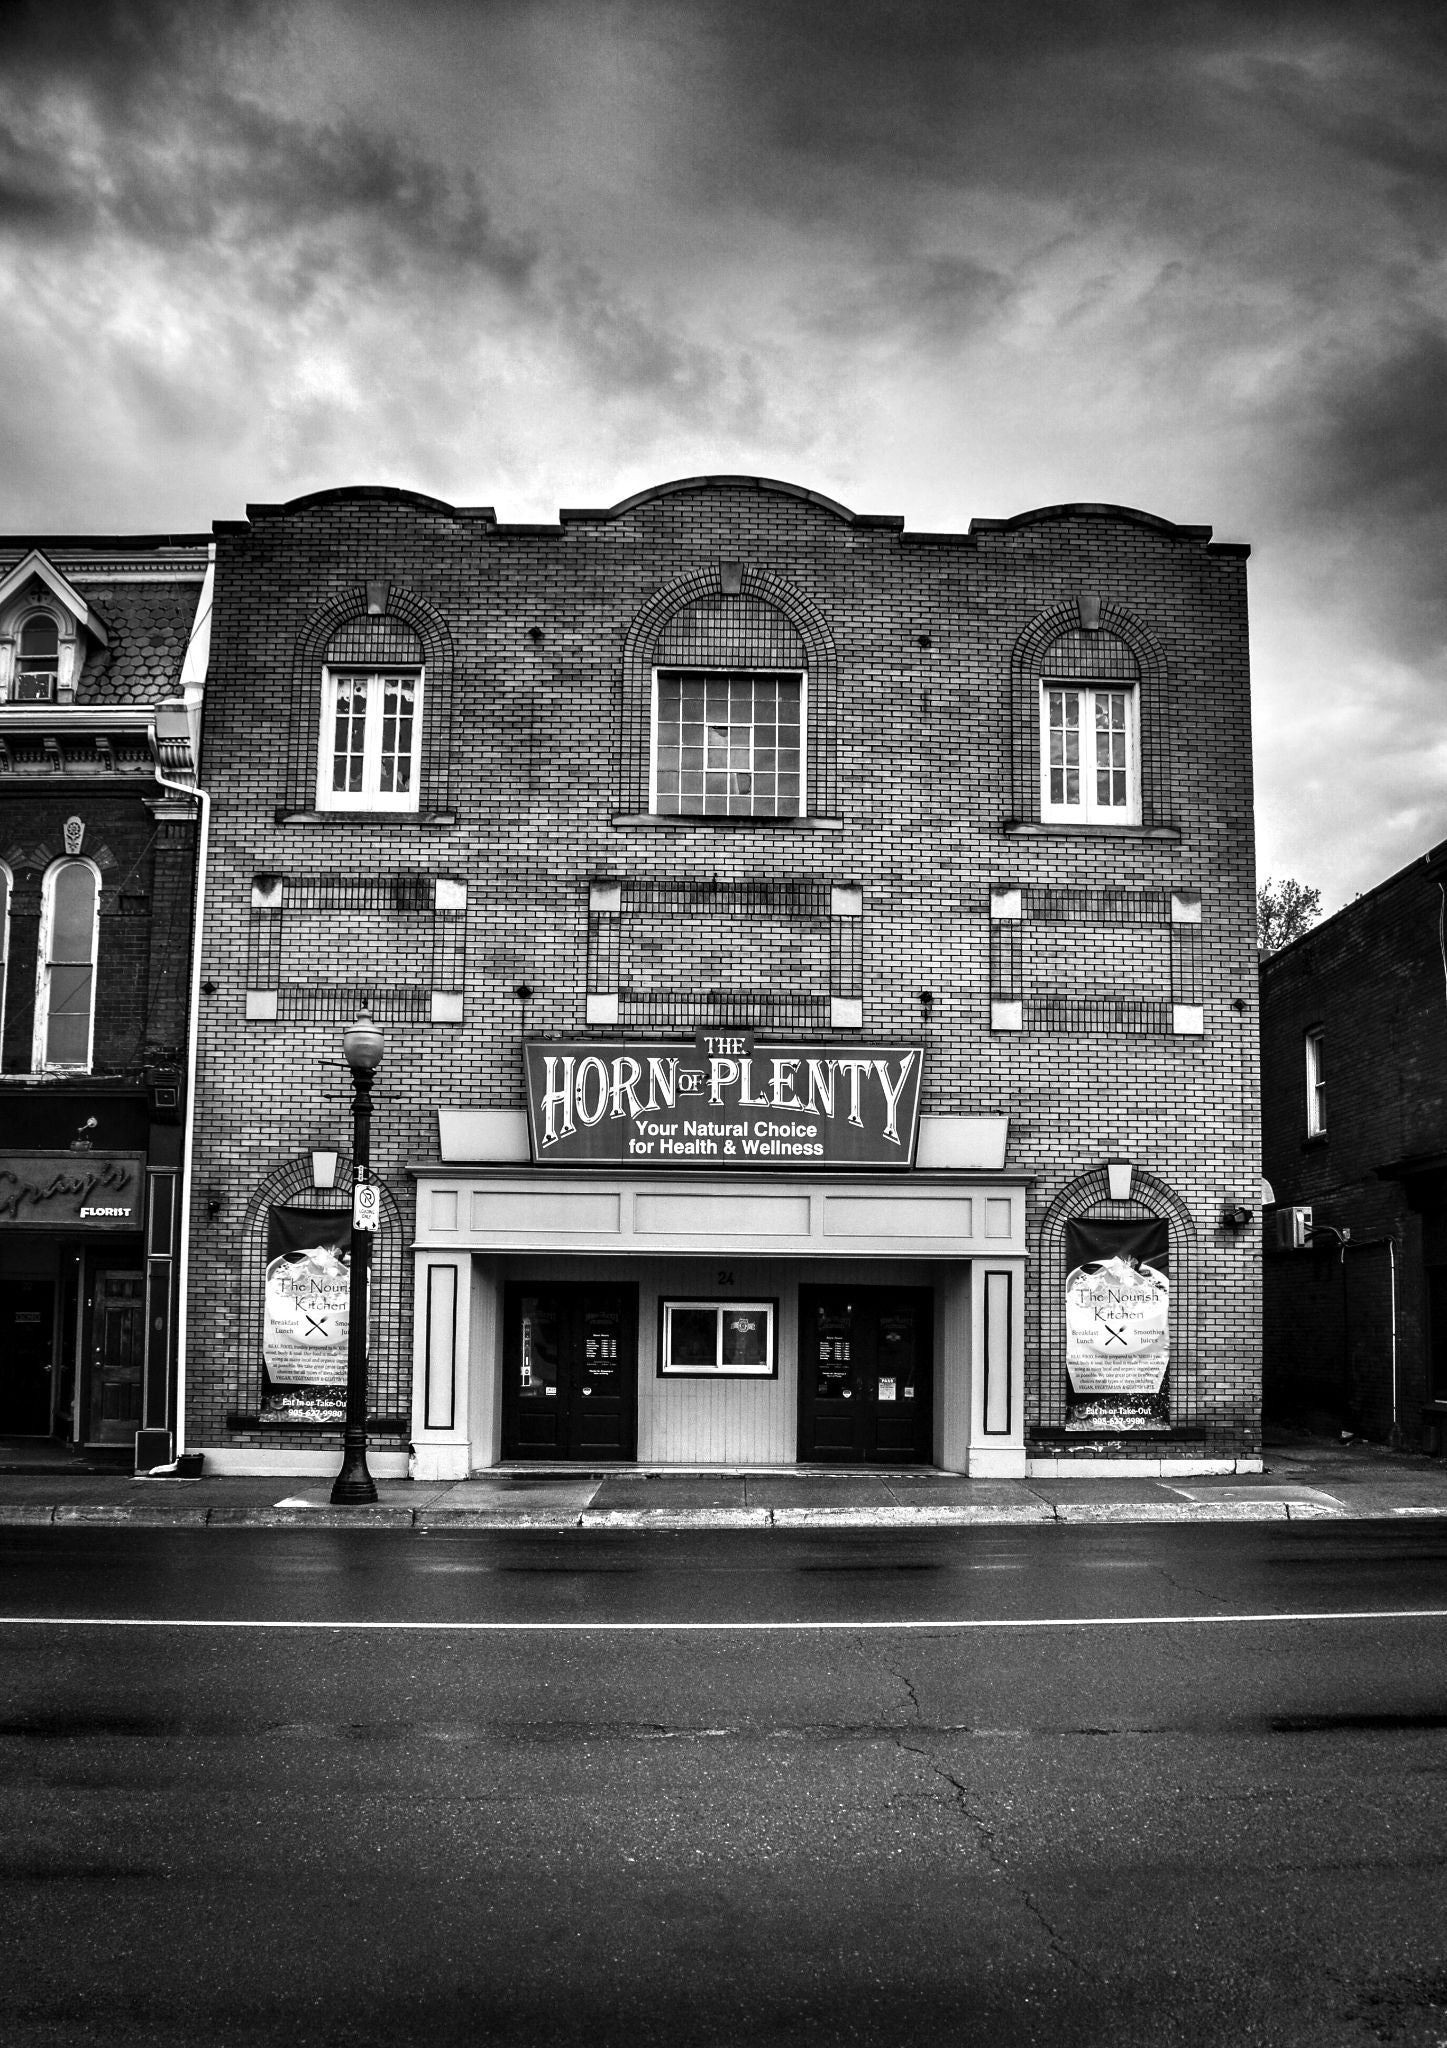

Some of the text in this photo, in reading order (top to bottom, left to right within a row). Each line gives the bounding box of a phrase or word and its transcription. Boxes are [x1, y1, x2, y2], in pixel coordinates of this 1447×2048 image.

[703, 1037, 744, 1055] THE
[541, 1050, 918, 1149] HORN OF PLENTY
[635, 1121, 818, 1138] Your Natural Choice
[629, 1139, 824, 1156] for Health & Wellness
[80, 1207, 131, 1218] FLORIST
[277, 1277, 306, 1292] The
[717, 1271, 735, 1285] 24
[295, 1296, 346, 1311] Kitchen
[1075, 1288, 1159, 1304] The Nourish
[1094, 1306, 1144, 1321] Kitchen
[282, 1397, 295, 1406] Eat
[296, 1398, 305, 1406] In
[315, 1399, 348, 1408] Take-Ou
[1085, 1406, 1099, 1415] Eat
[1099, 1406, 1107, 1415] In
[1118, 1406, 1152, 1415] Take-Out
